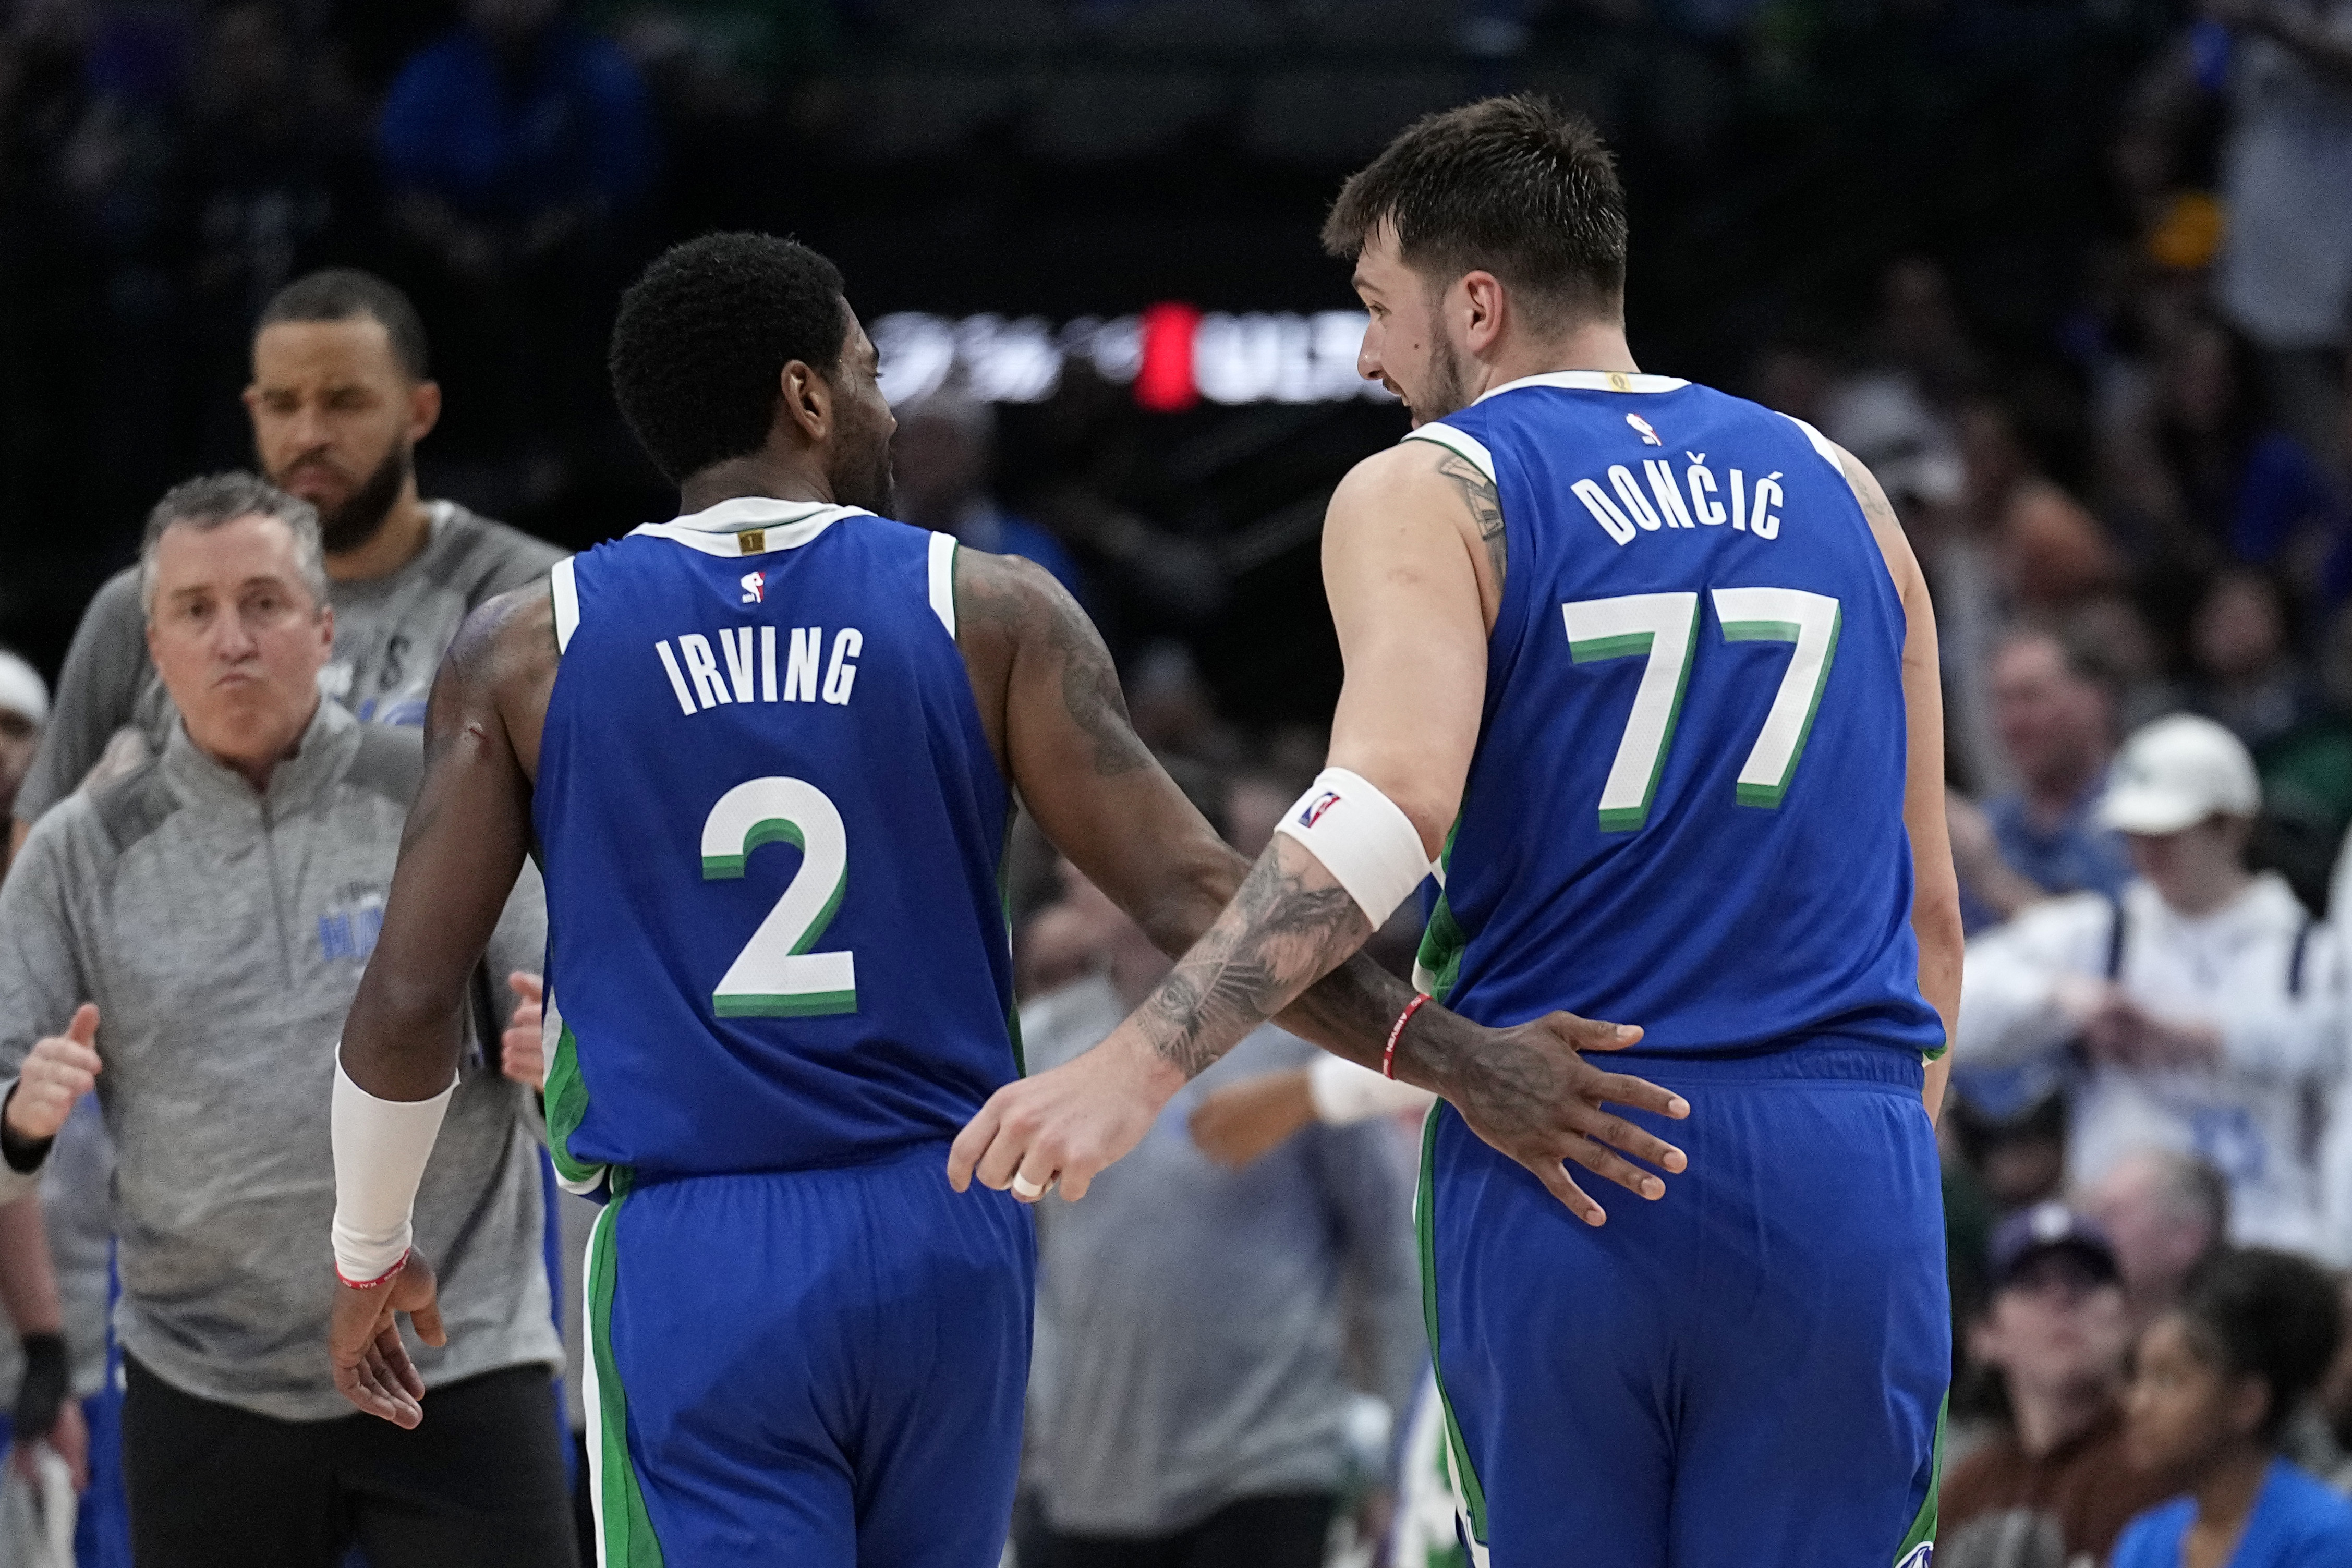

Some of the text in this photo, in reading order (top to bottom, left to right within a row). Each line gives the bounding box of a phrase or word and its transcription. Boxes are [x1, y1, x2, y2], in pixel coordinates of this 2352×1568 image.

[1570, 451, 1784, 546] DONČIĆ
[655, 626, 863, 716] IRVING
[1562, 587, 1842, 833] 77
[700, 775, 857, 1018] 2
